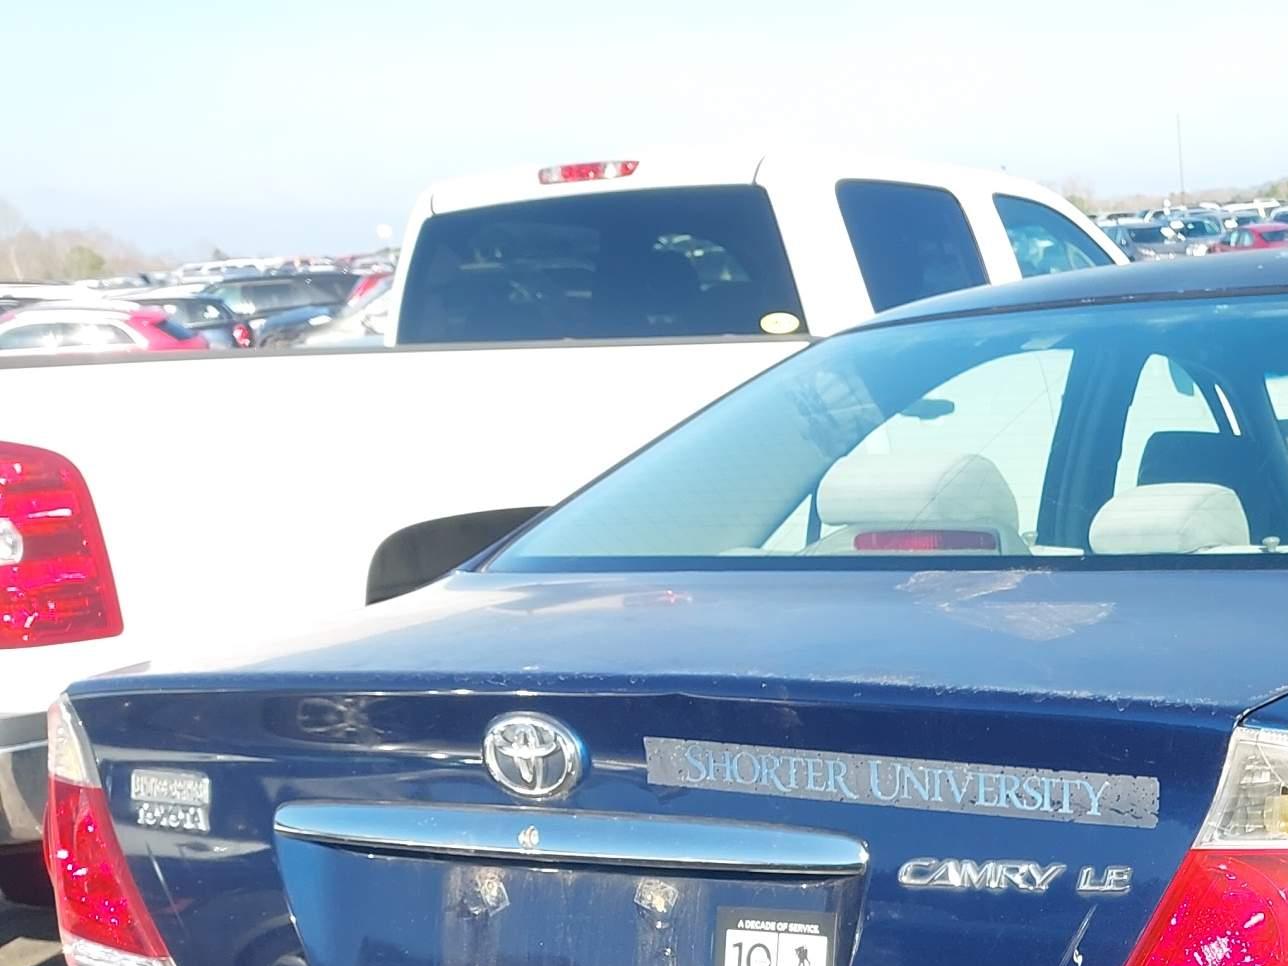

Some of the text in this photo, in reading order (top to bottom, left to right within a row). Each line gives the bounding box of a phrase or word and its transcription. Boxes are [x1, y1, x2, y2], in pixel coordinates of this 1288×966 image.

[685, 745, 1110, 815] SHORTER UNIVERSITY
[898, 858, 1133, 892] CAMRY LE
[737, 920, 744, 928] A
[745, 920, 776, 931] DECADE
[777, 922, 788, 931] OF
